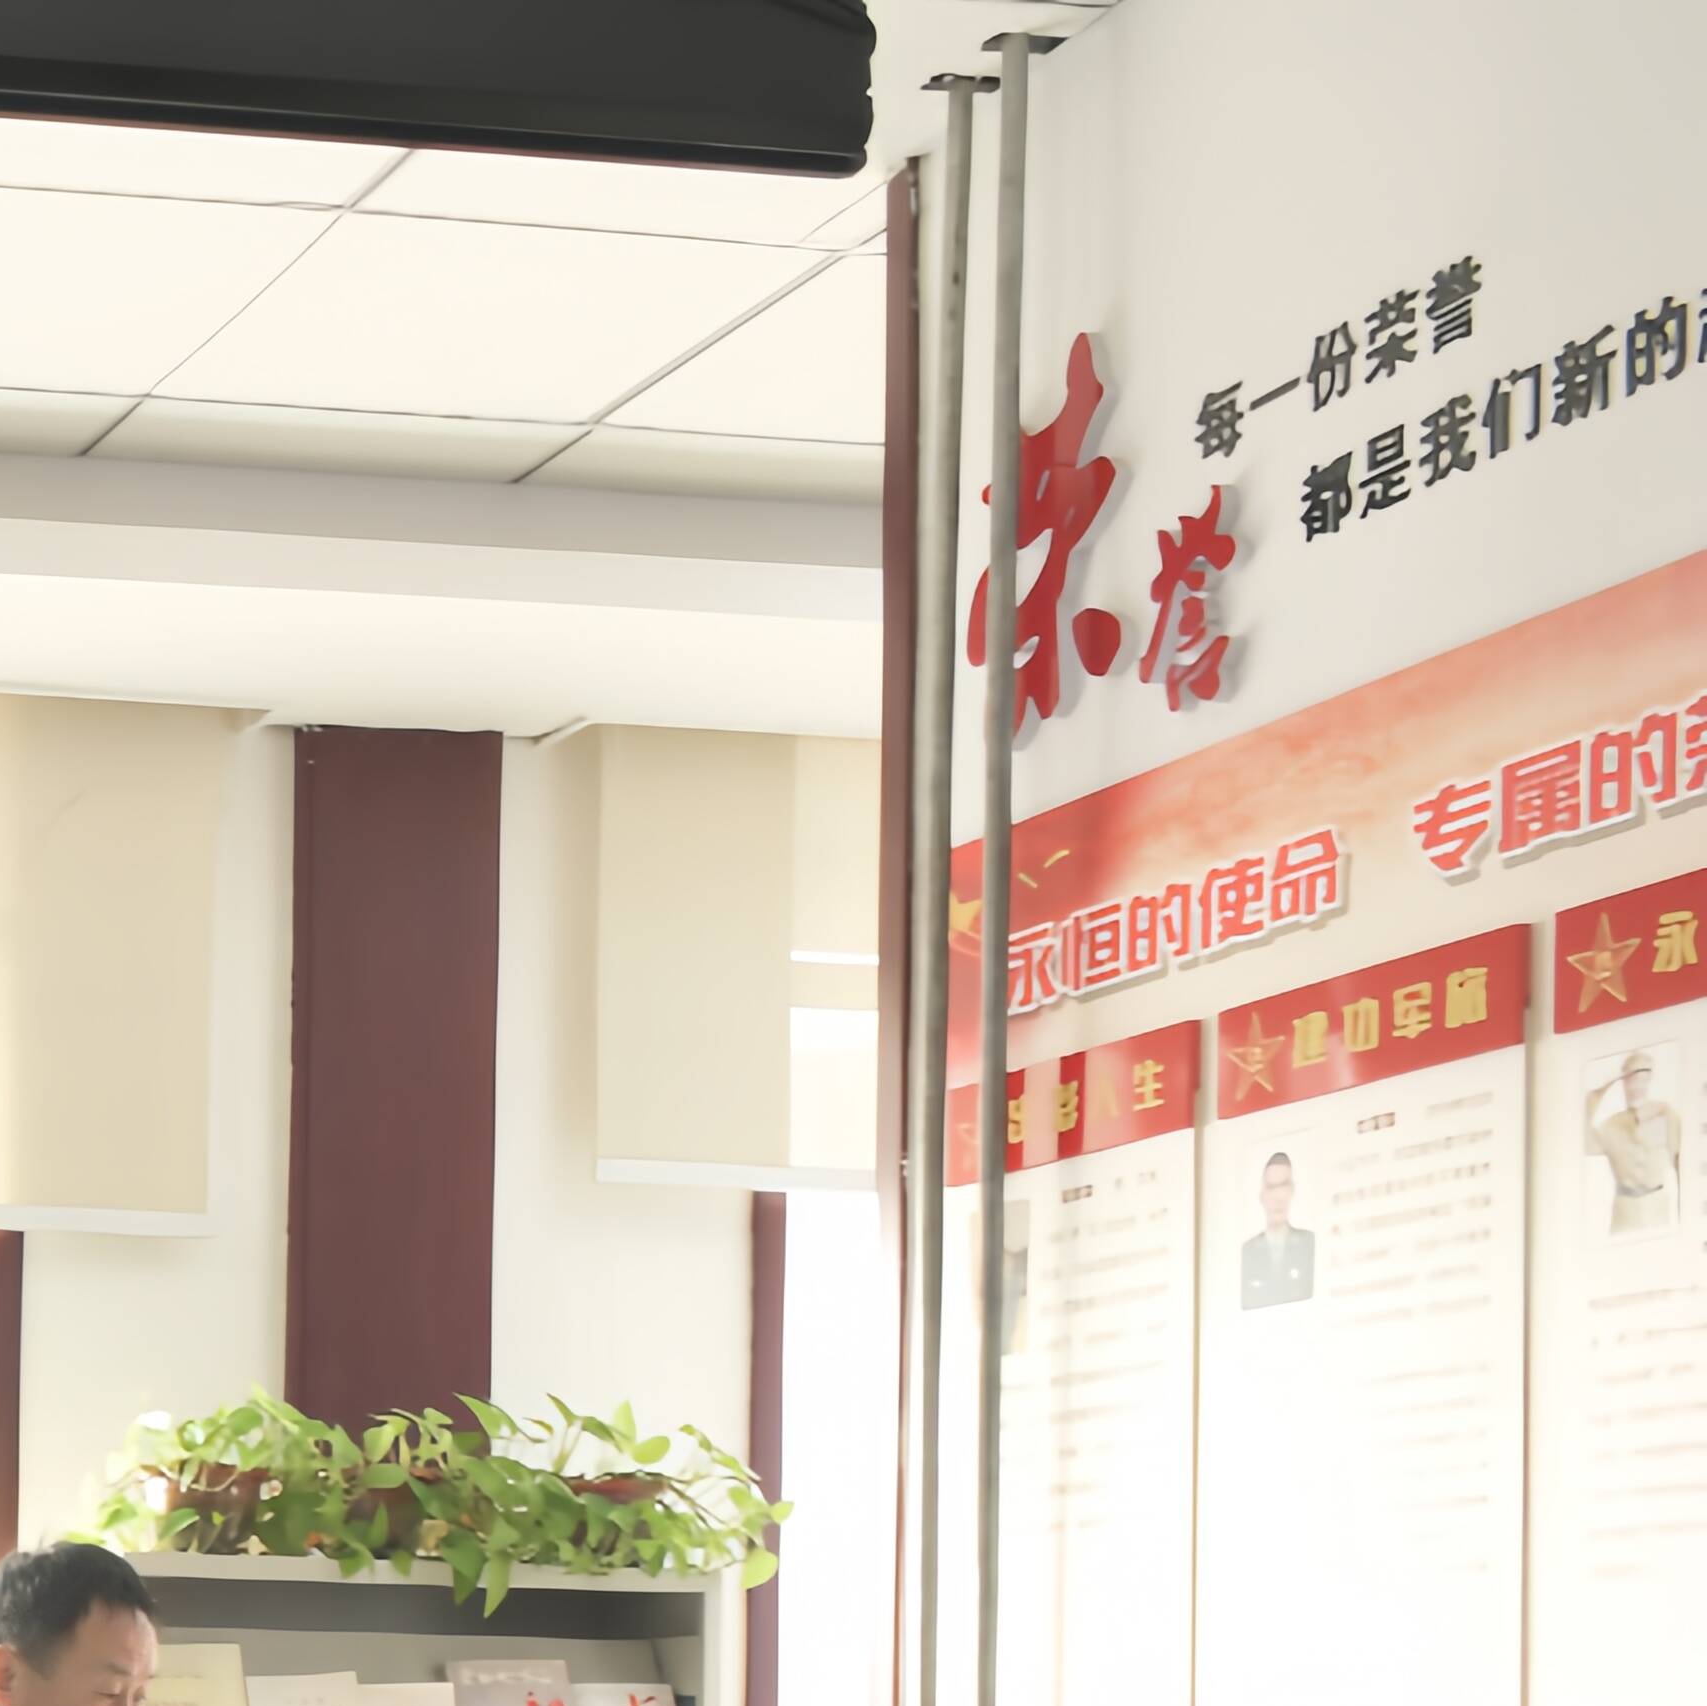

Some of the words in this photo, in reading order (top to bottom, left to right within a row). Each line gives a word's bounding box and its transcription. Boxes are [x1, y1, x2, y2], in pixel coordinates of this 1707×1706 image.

[1194, 255, 1483, 461] 每一份荣誉
[1299, 288, 1707, 542] 都是我们新的
[1008, 830, 1341, 1010] 永恒的使命
[1651, 910, 1699, 974] 永
